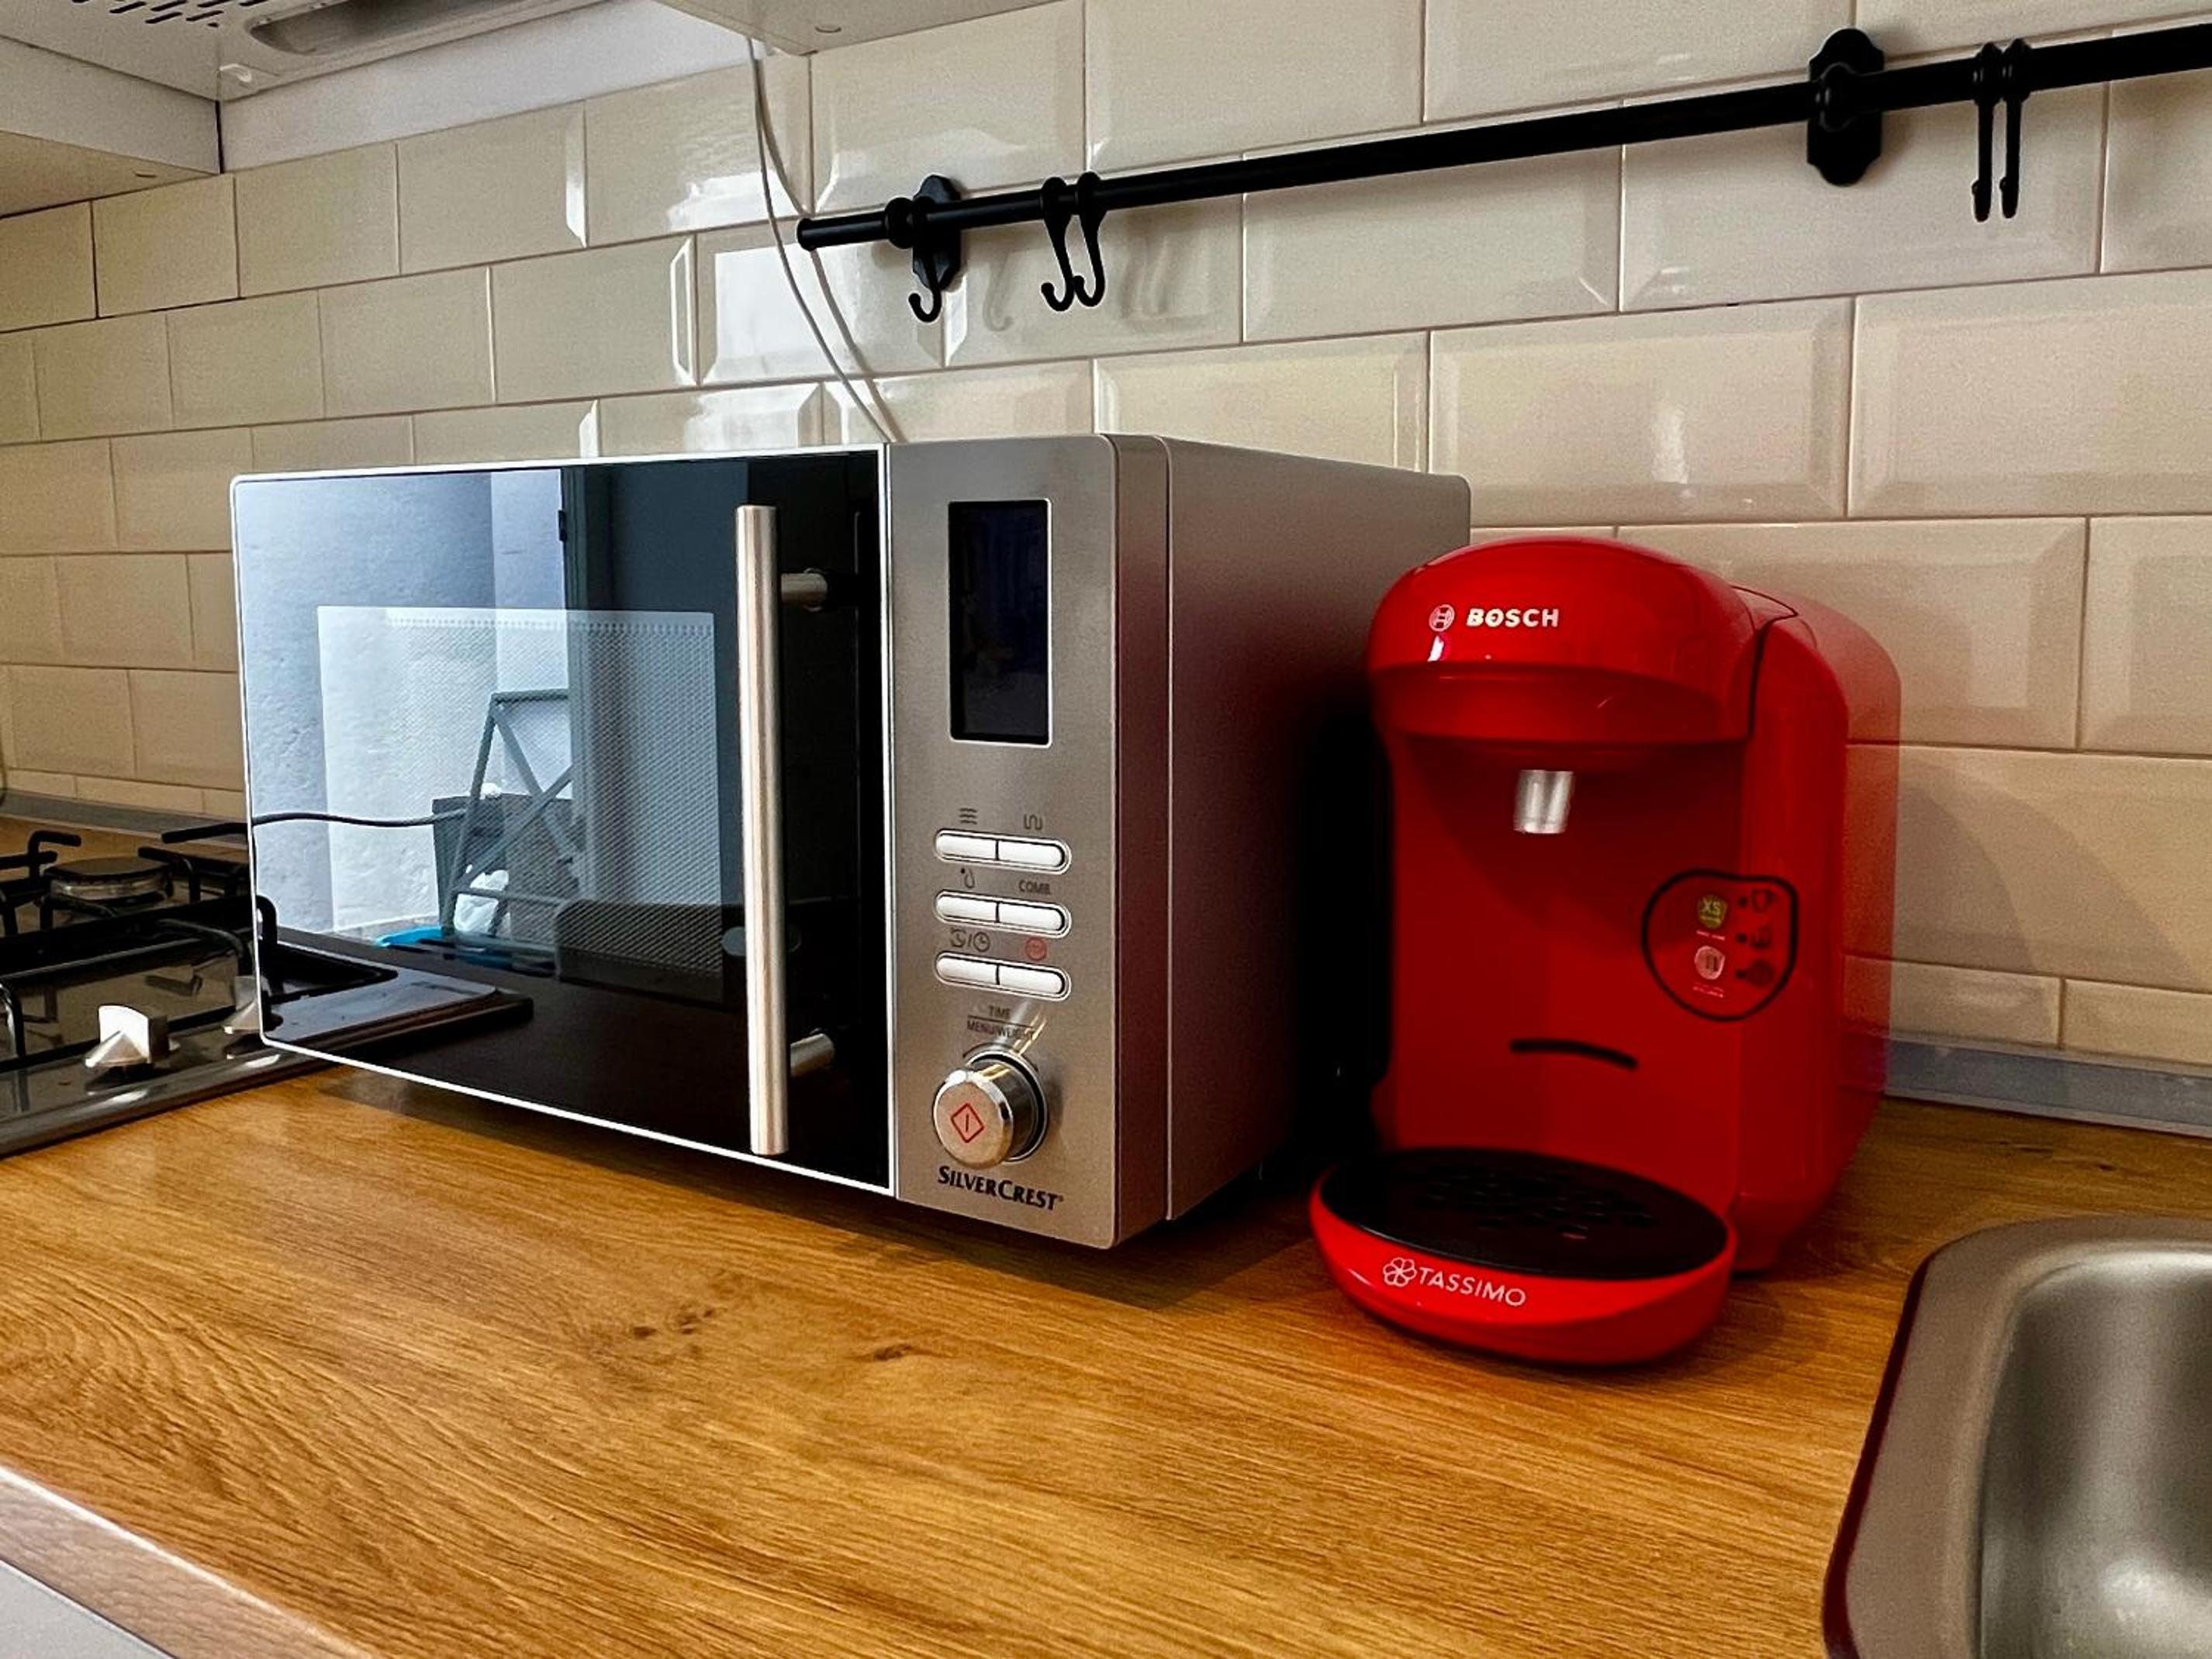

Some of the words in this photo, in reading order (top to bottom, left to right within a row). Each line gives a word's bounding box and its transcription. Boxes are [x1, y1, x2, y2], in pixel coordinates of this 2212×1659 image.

[1466, 607, 1560, 627] BOSCH
[937, 1165, 1060, 1211] SILVERCREST
[1419, 1267, 1526, 1306] TASSIMO
